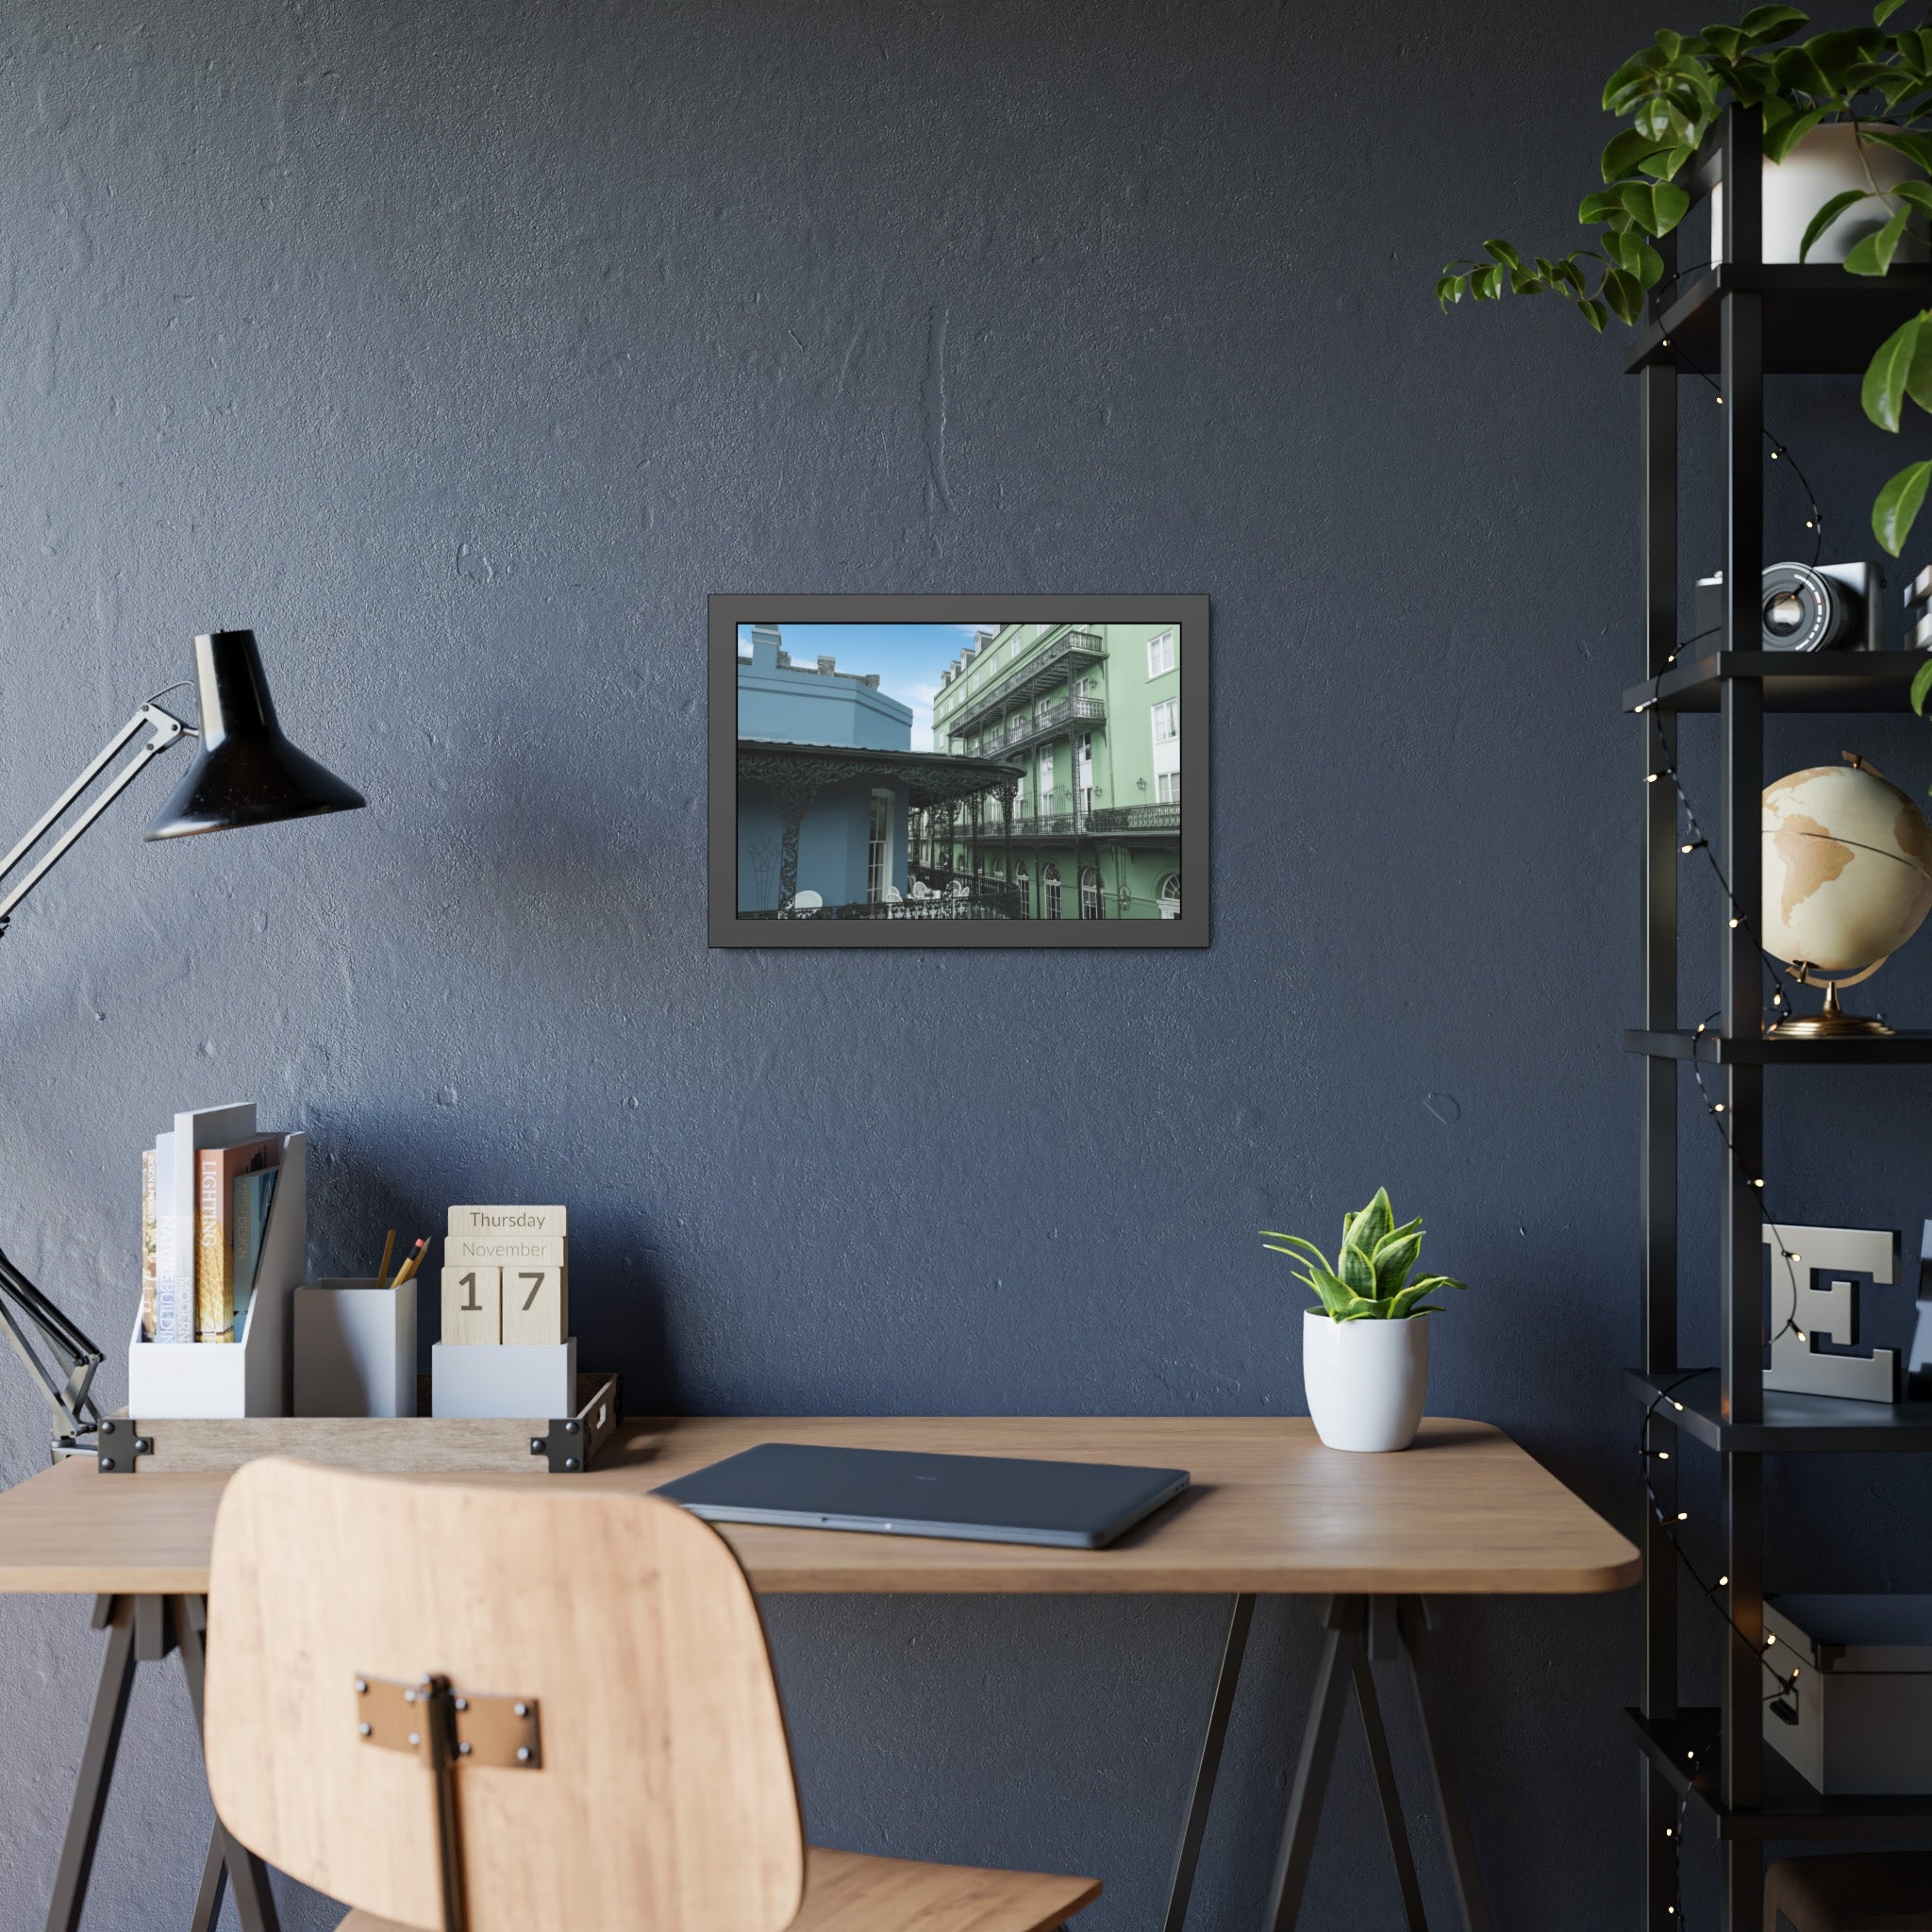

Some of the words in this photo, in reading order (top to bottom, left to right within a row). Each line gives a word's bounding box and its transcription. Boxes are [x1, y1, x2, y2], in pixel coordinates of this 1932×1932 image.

[202, 1160, 217, 1247] LIGHTING
[469, 1211, 546, 1230] Thursday
[237, 1217, 248, 1259] DESIGN
[462, 1241, 547, 1257] November
[177, 1276, 191, 1341] MODERN
